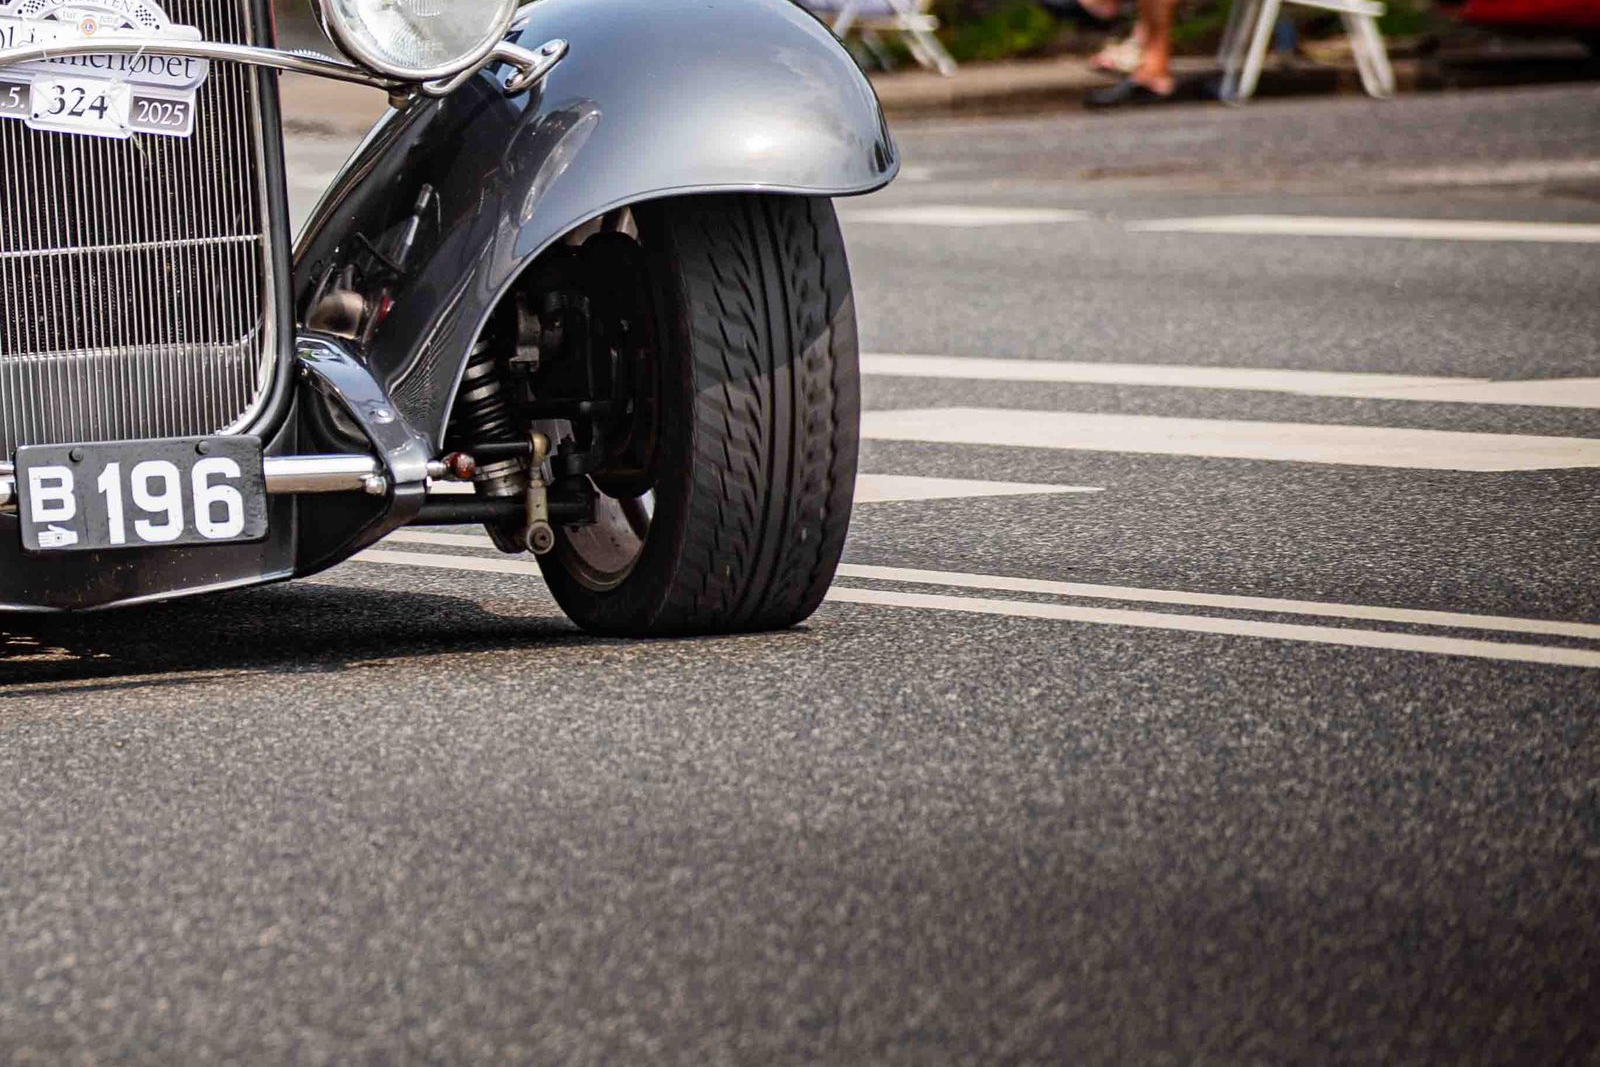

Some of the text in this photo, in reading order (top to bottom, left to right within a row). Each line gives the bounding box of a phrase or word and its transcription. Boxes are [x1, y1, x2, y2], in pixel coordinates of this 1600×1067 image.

[46, 84, 109, 120] 324
[137, 100, 186, 126] 2025
[28, 457, 245, 545] B 196
